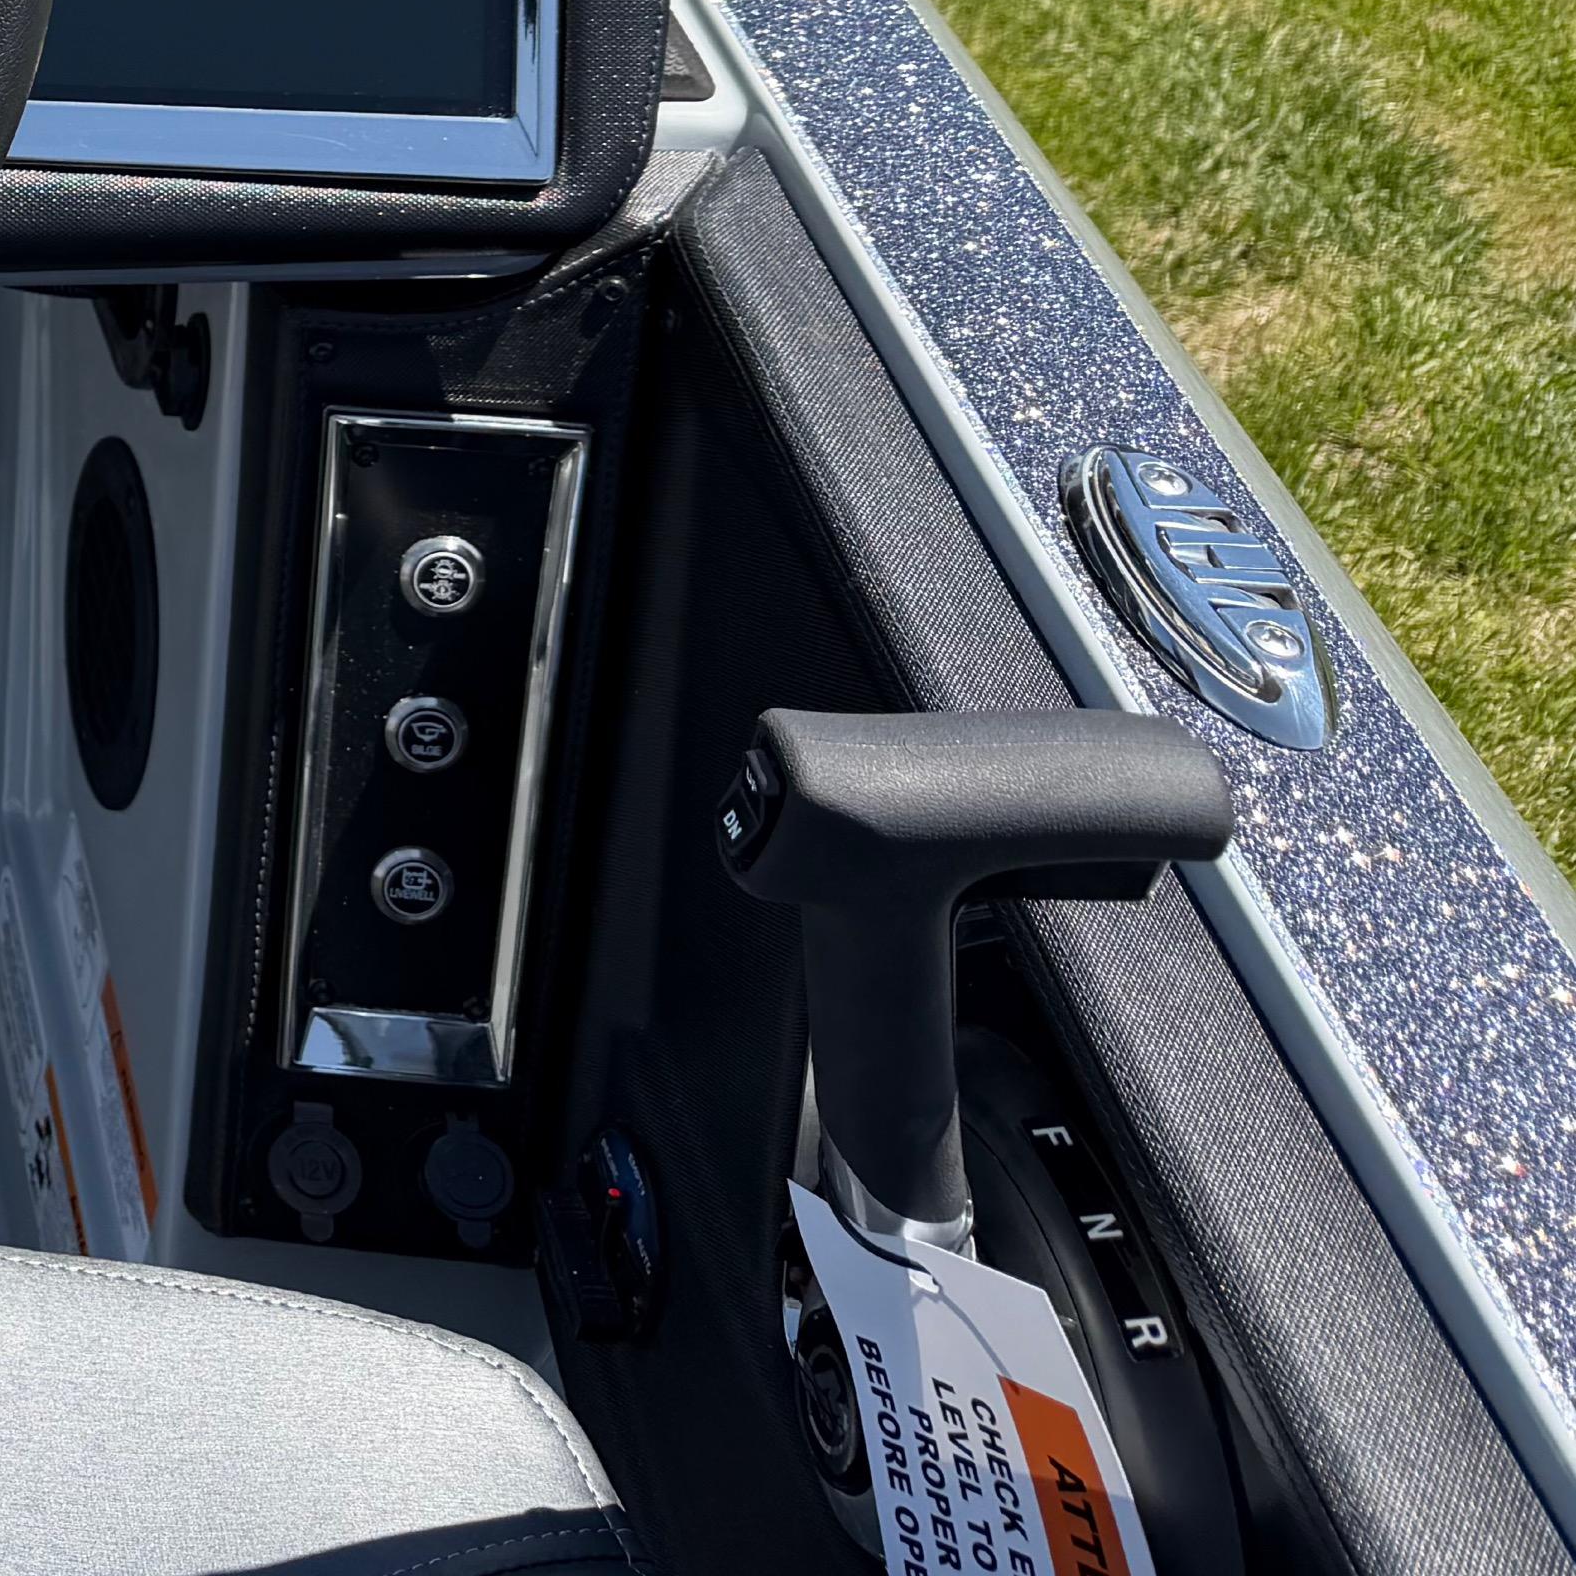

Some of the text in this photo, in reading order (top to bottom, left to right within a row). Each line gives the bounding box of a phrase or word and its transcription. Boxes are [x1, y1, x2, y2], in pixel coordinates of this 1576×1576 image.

[723, 809, 743, 840] DN
[1032, 1126, 1073, 1146] F
[1079, 1213, 1124, 1240] N
[1124, 1316, 1169, 1348] R
[856, 1334, 913, 1497] BEFORE
[908, 1405, 962, 1571] PROPER
[932, 1377, 997, 1572] LEVEL TO
[971, 1397, 1036, 1576] CHECK E
